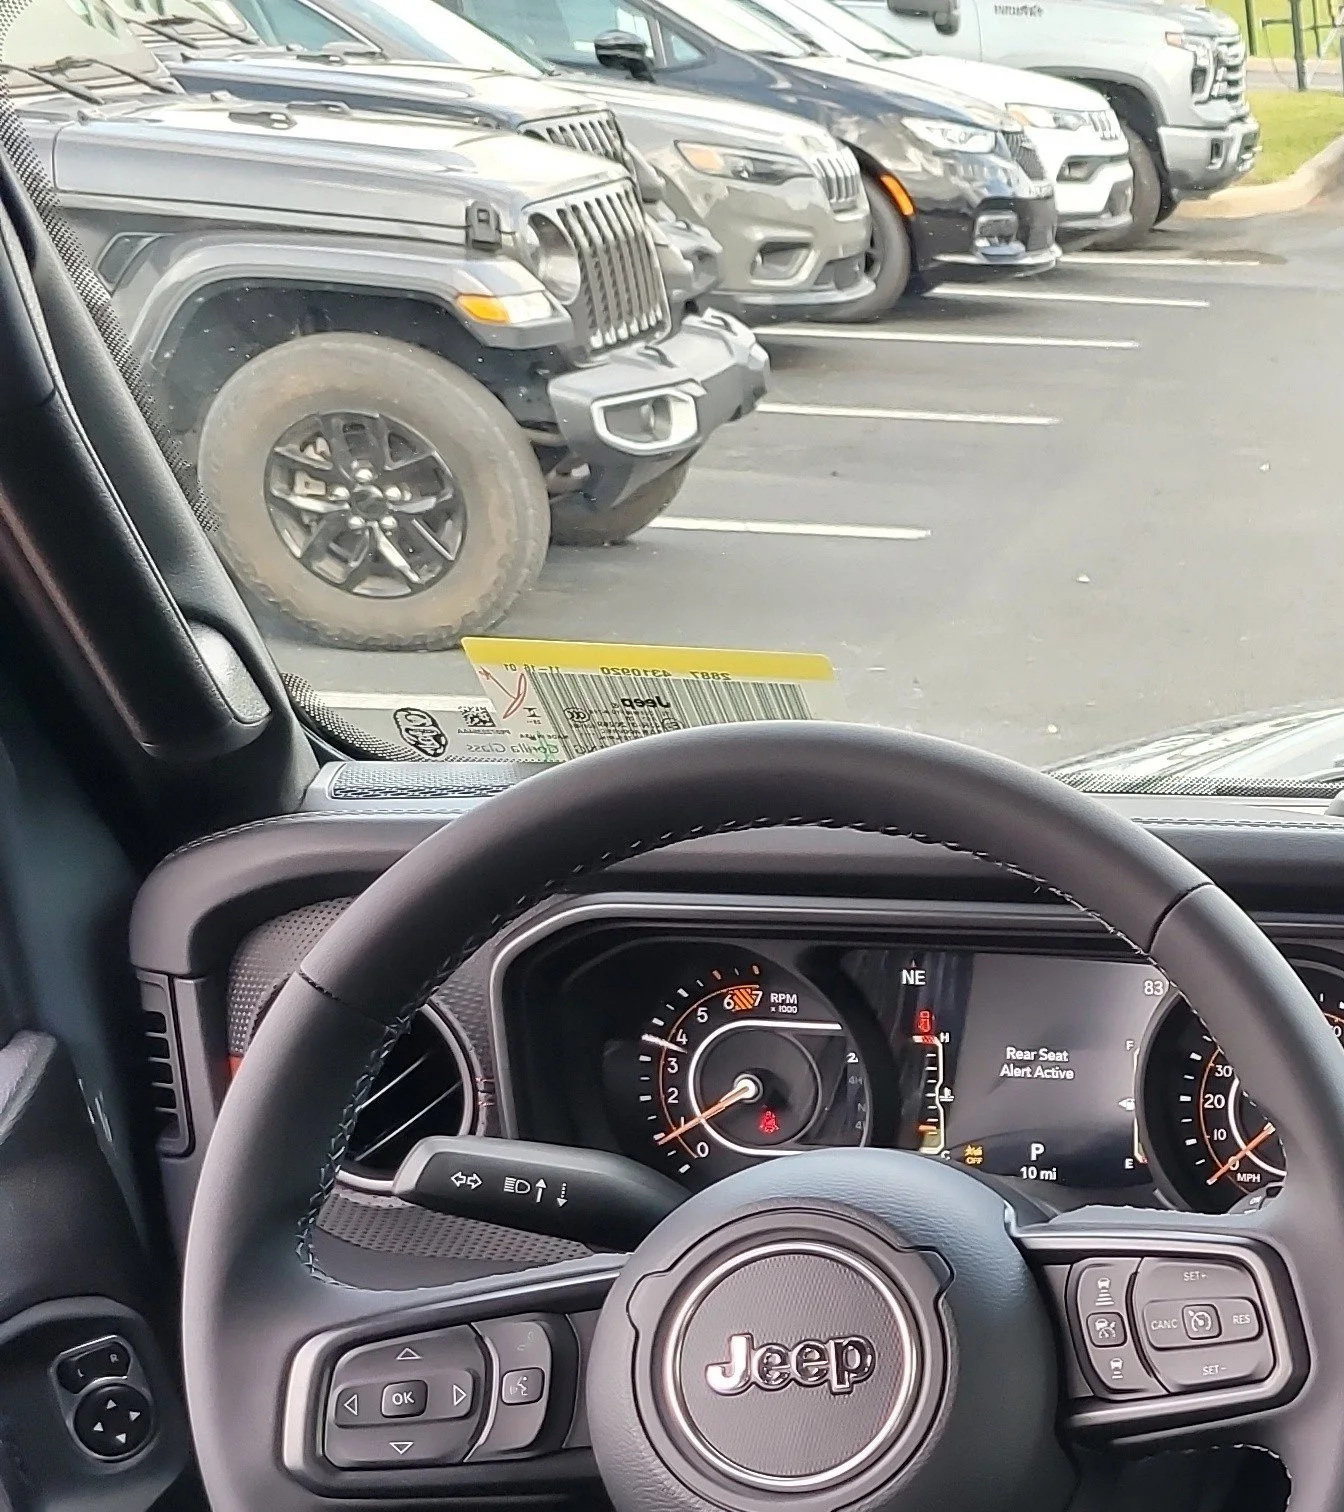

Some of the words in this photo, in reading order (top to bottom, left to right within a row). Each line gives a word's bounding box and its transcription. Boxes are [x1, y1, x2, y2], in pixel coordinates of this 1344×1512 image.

[902, 970, 925, 985] NE
[1144, 981, 1163, 995] 83
[724, 995, 733, 1010] 6
[752, 991, 762, 1006] 7
[770, 993, 797, 1004] RPM
[697, 1008, 708, 1023] 5
[778, 1005, 797, 1014] 1000
[676, 1030, 688, 1044] 4
[941, 1033, 949, 1043] H
[1126, 1041, 1133, 1050] F
[1006, 1047, 1037, 1061] Rear
[1039, 1049, 1068, 1062] Seat
[668, 1058, 678, 1073] 3
[1000, 1065, 1031, 1078] Alert
[1033, 1066, 1074, 1079] Active
[1214, 1065, 1232, 1078] 30
[668, 1089, 678, 1103] 2
[1204, 1094, 1225, 1108] 20
[1213, 1129, 1226, 1141] 10
[697, 1143, 709, 1157] 0
[1031, 1143, 1044, 1160] P
[1125, 1159, 1133, 1168] E
[1020, 1167, 1036, 1179] 10
[1039, 1167, 1056, 1180] mi
[1237, 1173, 1260, 1183] MPH
[1151, 1319, 1178, 1330] CANC
[1233, 1315, 1251, 1325] RES
[705, 1333, 876, 1396] Jeep
[392, 1391, 414, 1405] OK
